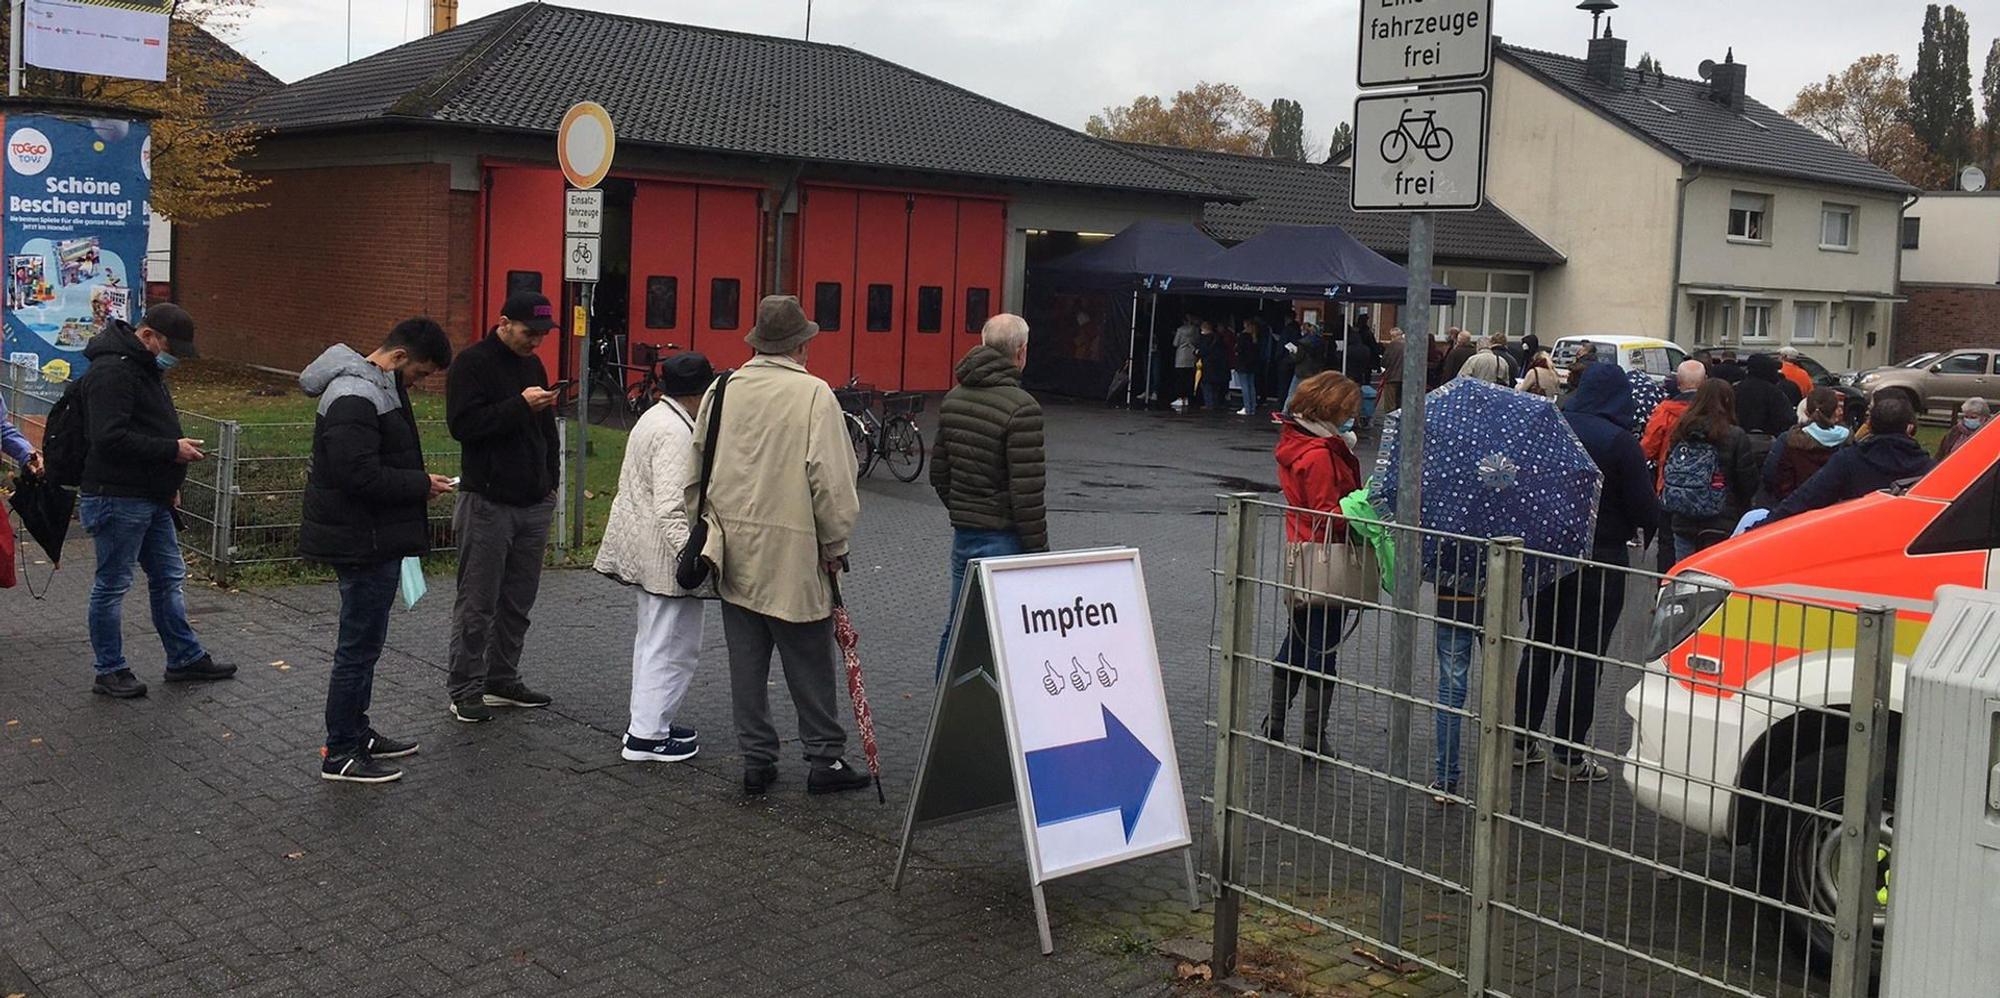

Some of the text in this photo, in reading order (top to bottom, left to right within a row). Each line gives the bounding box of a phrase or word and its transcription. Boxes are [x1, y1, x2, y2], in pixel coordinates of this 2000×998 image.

[1371, 11, 1479, 39] fahrzeuge
[1404, 42, 1440, 67] frei
[11, 142, 47, 155] TOGGO
[46, 177, 120, 195] Schöne
[1395, 170, 1434, 195] frei
[10, 196, 131, 218] Bescherung!
[571, 194, 597, 205] Einsatz-
[40, 216, 60, 225] Spiele
[61, 216, 72, 225] für
[72, 217, 84, 225] die
[568, 207, 599, 219] fahrzeuge
[577, 219, 589, 228] frei
[576, 266, 588, 275] frei
[1021, 596, 1118, 638] Impfen
